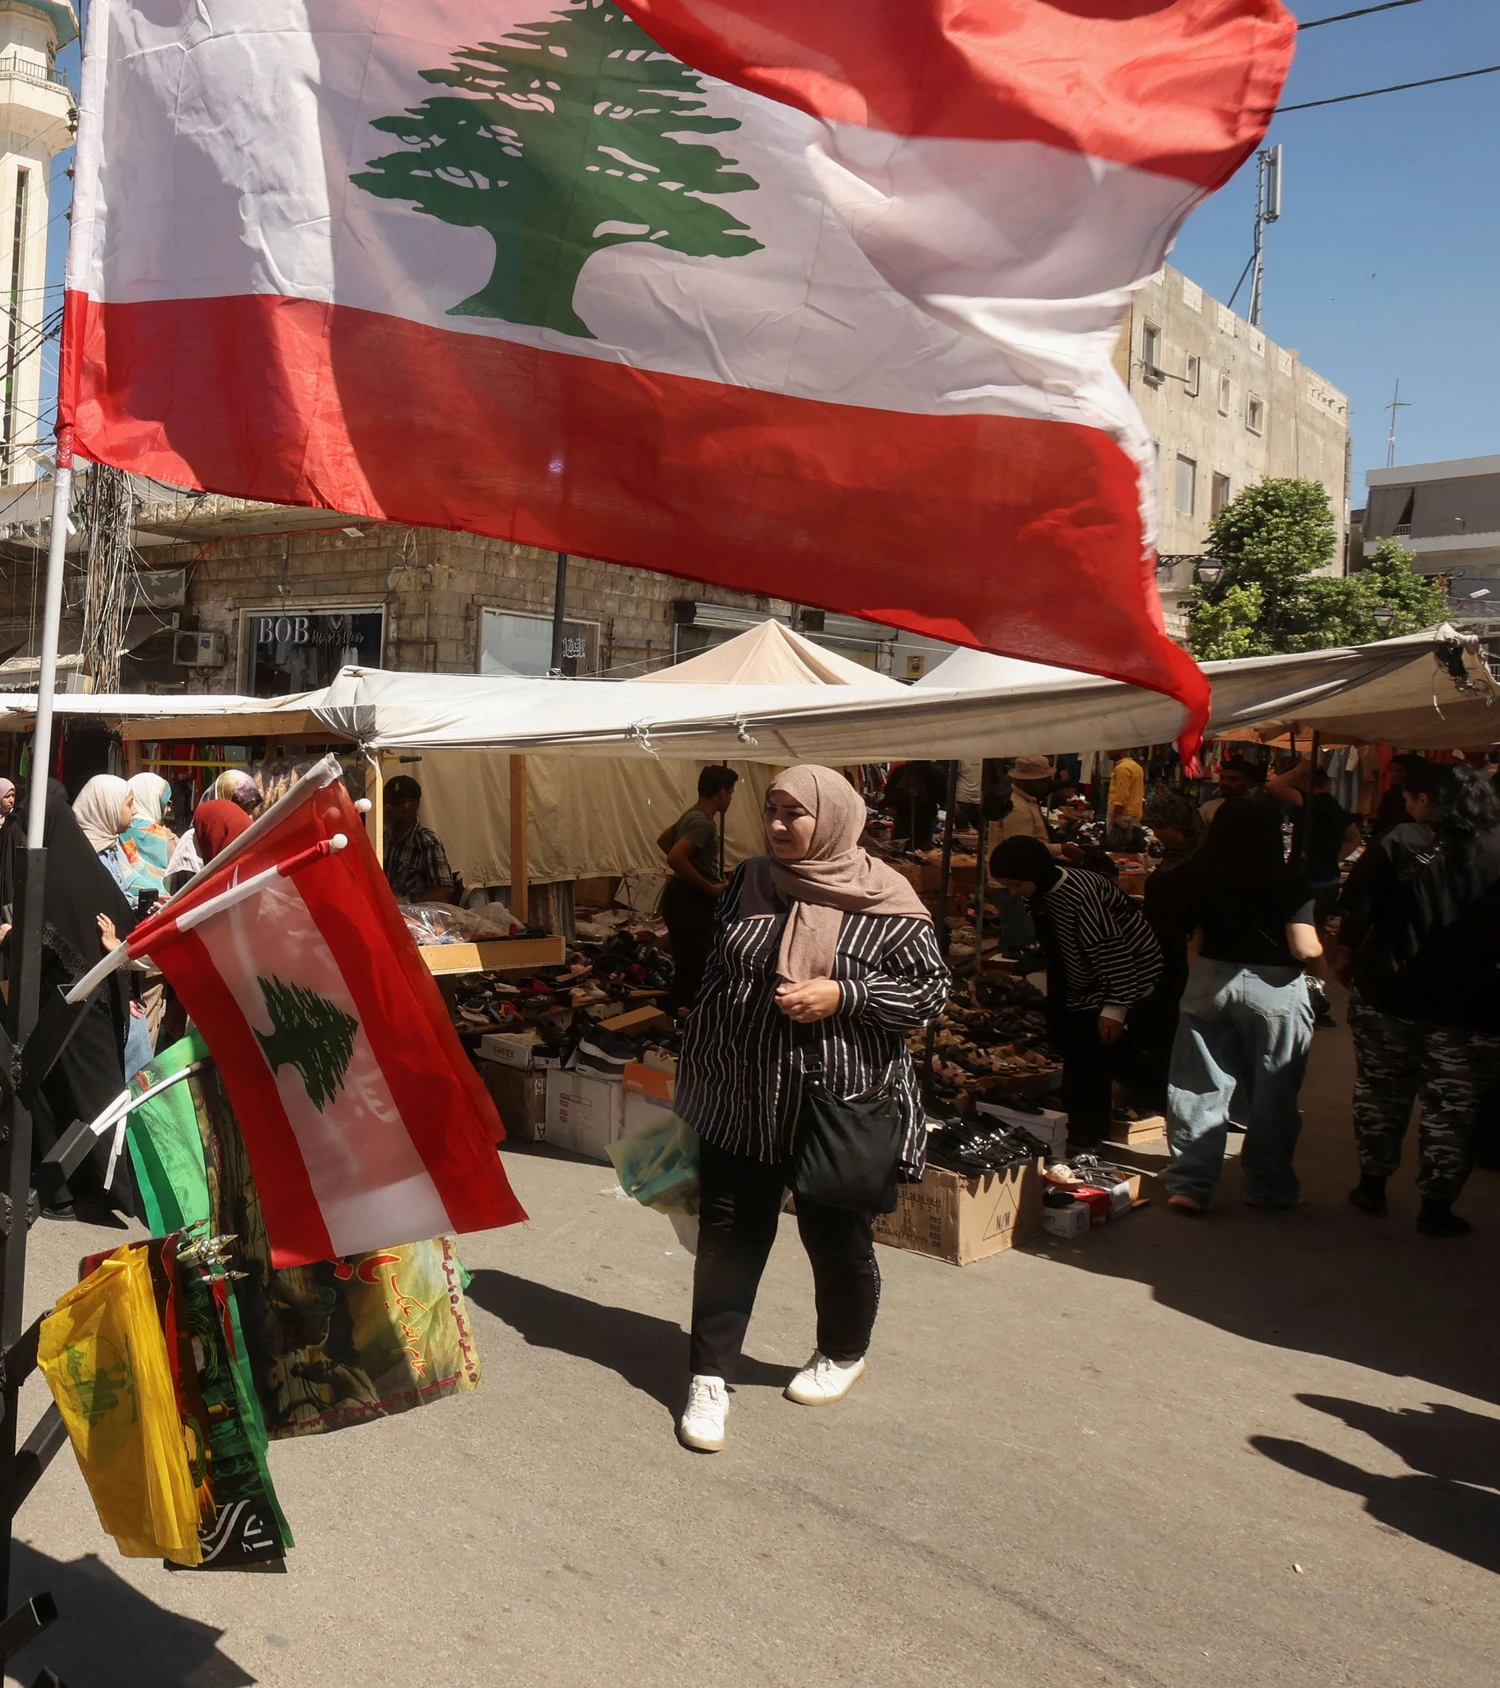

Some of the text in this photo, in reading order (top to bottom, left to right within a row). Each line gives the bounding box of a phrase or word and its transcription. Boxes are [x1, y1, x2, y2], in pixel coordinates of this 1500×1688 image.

[259, 617, 310, 643] BOB
[493, 1045, 515, 1059] SHOES
[995, 1211, 1011, 1231] N/M
